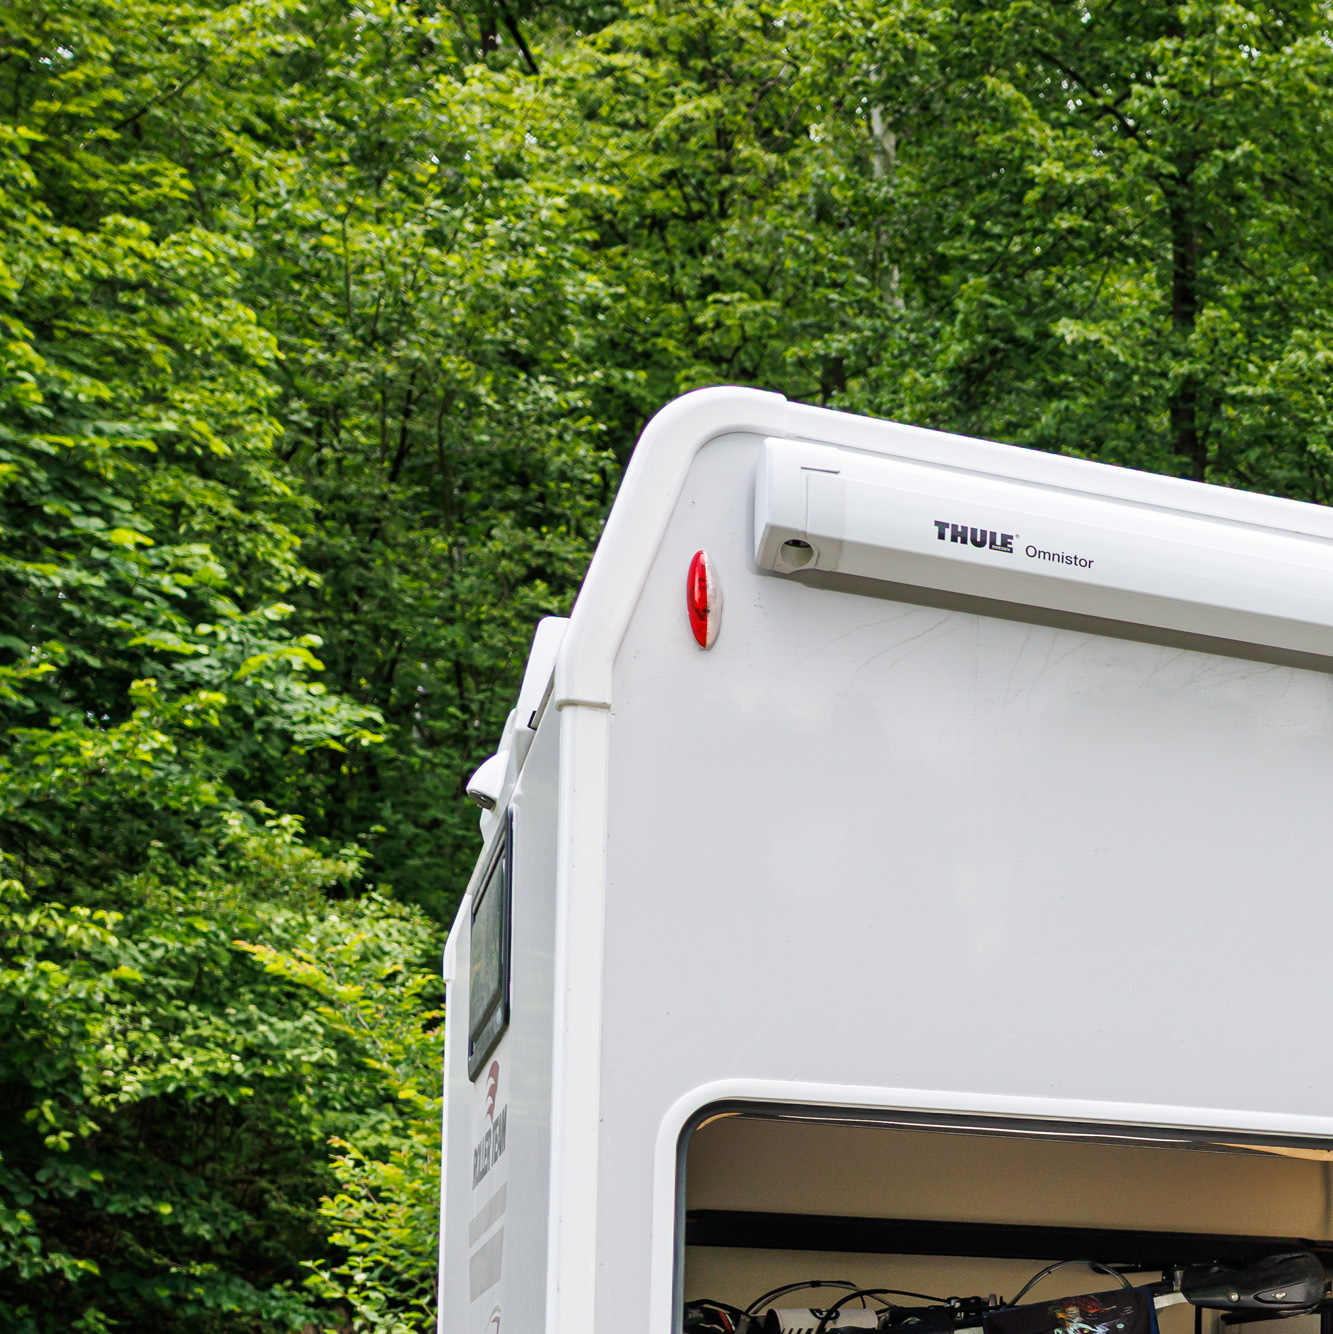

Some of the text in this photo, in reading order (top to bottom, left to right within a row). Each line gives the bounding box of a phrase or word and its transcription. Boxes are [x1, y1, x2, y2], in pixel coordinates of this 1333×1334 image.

[934, 520, 1095, 569] THULE Omnistor
[472, 1104, 507, 1191] ROLLER TEAM
